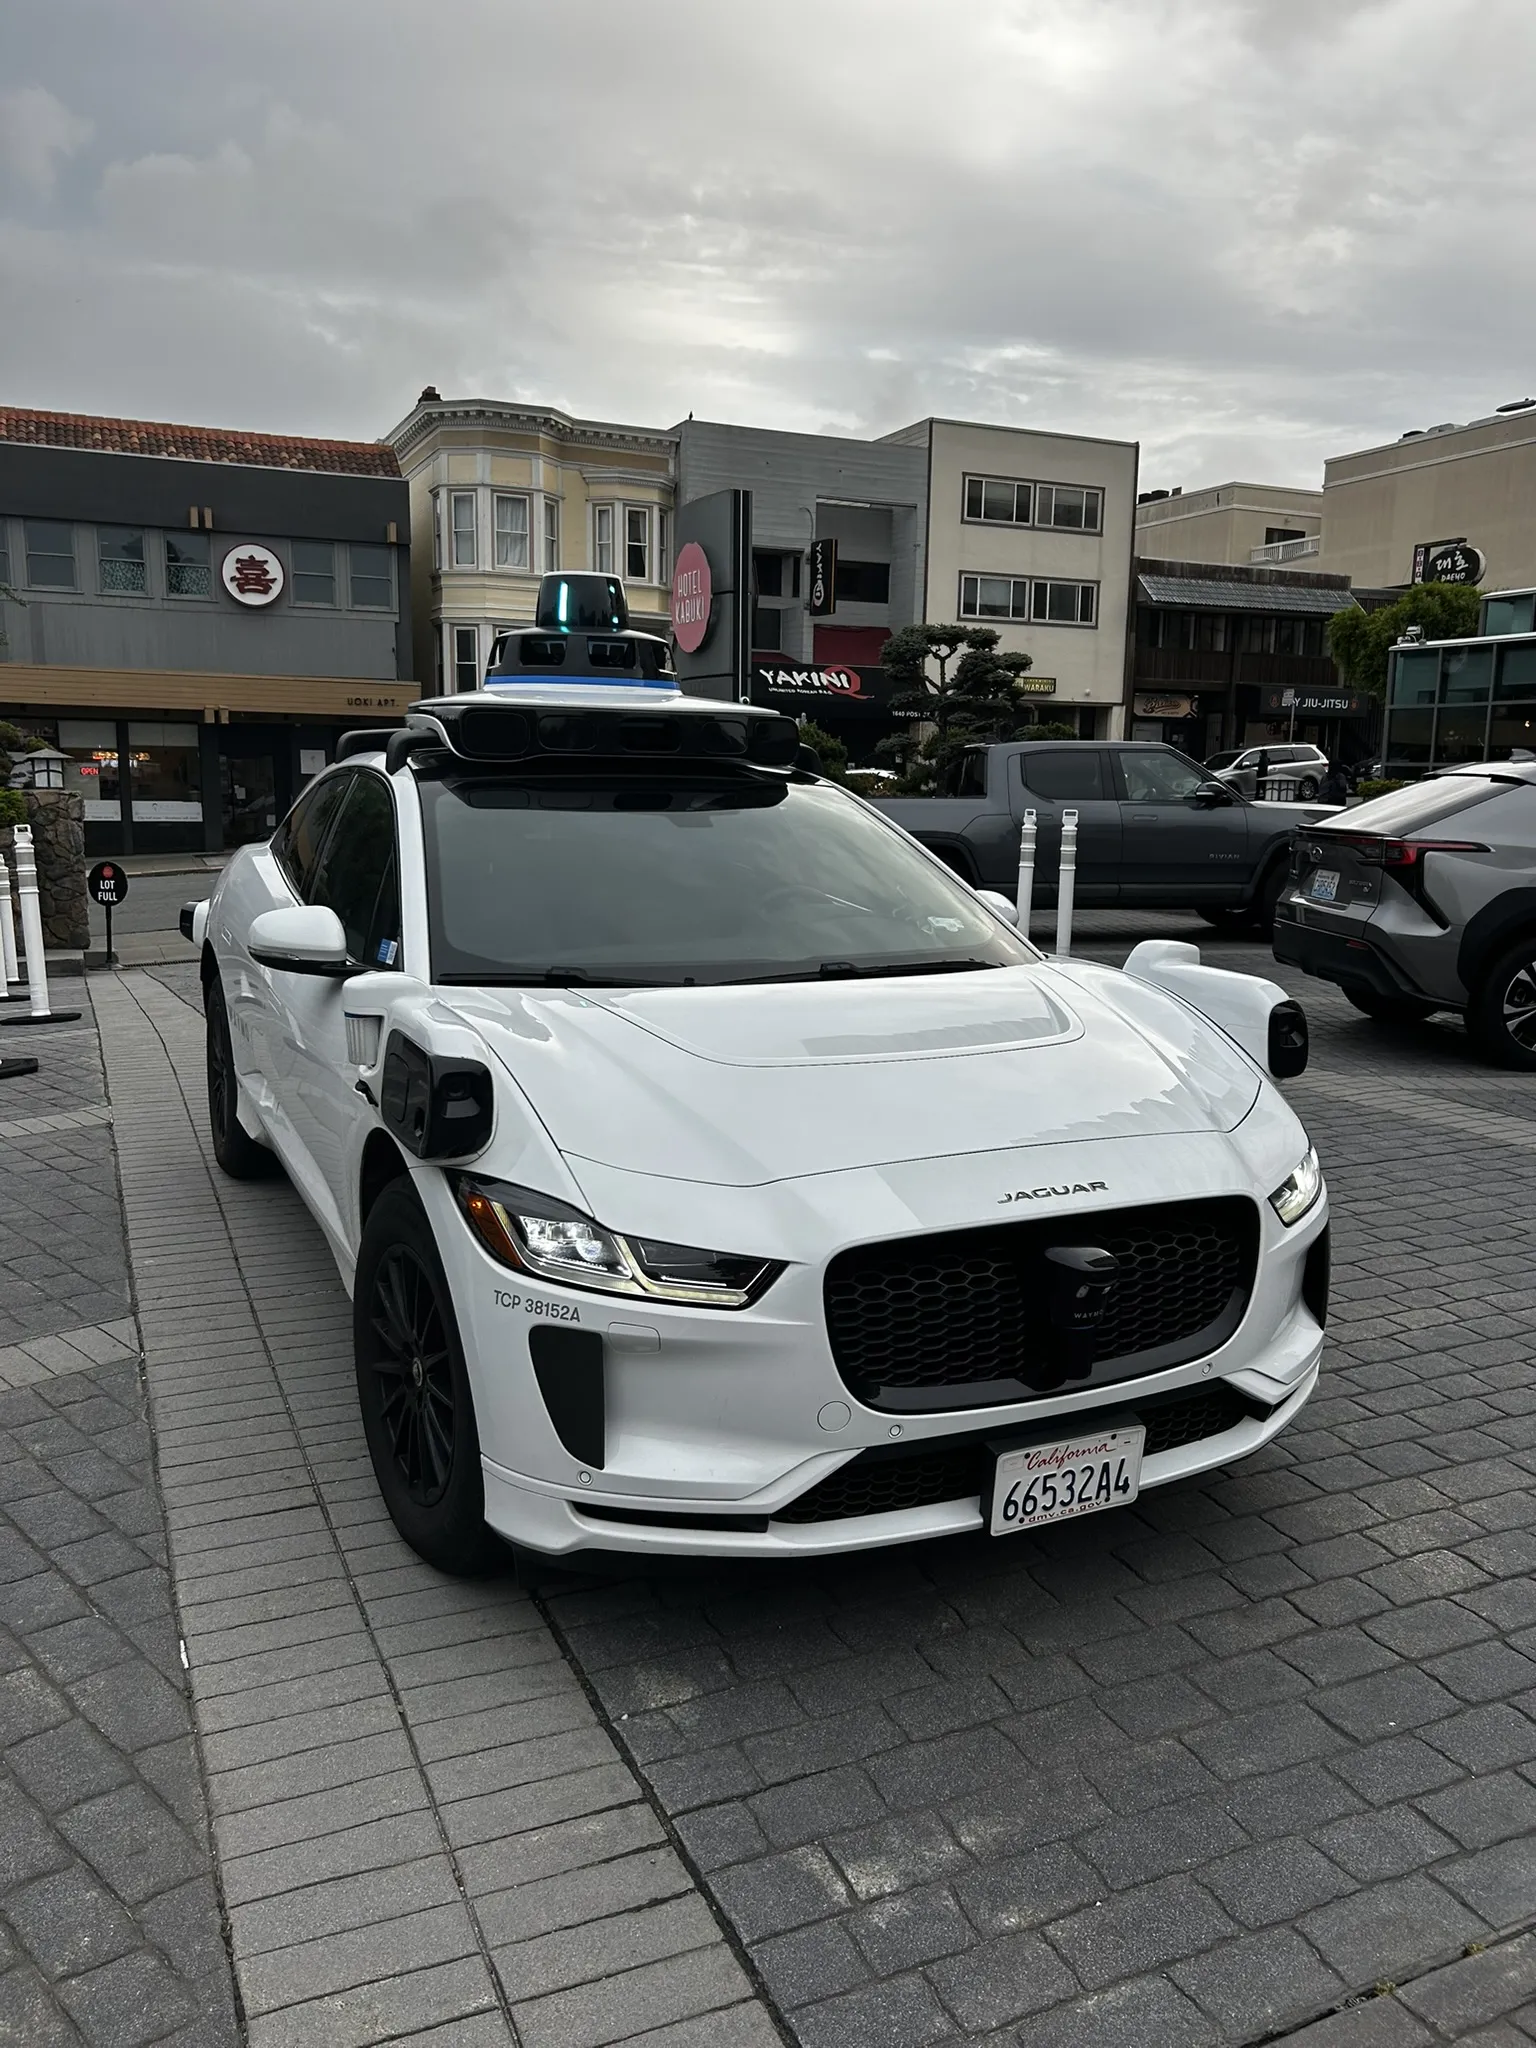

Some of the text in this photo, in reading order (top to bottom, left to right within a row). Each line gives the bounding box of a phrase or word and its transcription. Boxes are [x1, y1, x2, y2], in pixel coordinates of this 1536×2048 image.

[230, 554, 277, 595] 喜
[678, 569, 702, 598] HOTEL
[1441, 572, 1466, 582] DAEHO
[675, 595, 705, 625] KABUKI
[1024, 684, 1055, 692] WARAKU
[347, 697, 400, 707] UOKI APT.
[1302, 698, 1349, 709] JIU-JITSU
[81, 767, 99, 775] OPEN
[97, 891, 118, 901] FULL
[100, 880, 115, 890] LOT
[997, 1181, 1109, 1205] JAGUAR
[493, 1289, 581, 1322] TCP 38152A
[1027, 1442, 1118, 1471] California
[1003, 1457, 1130, 1522] 66532A4
[1028, 1500, 1103, 1524] dmv.ca.gov
